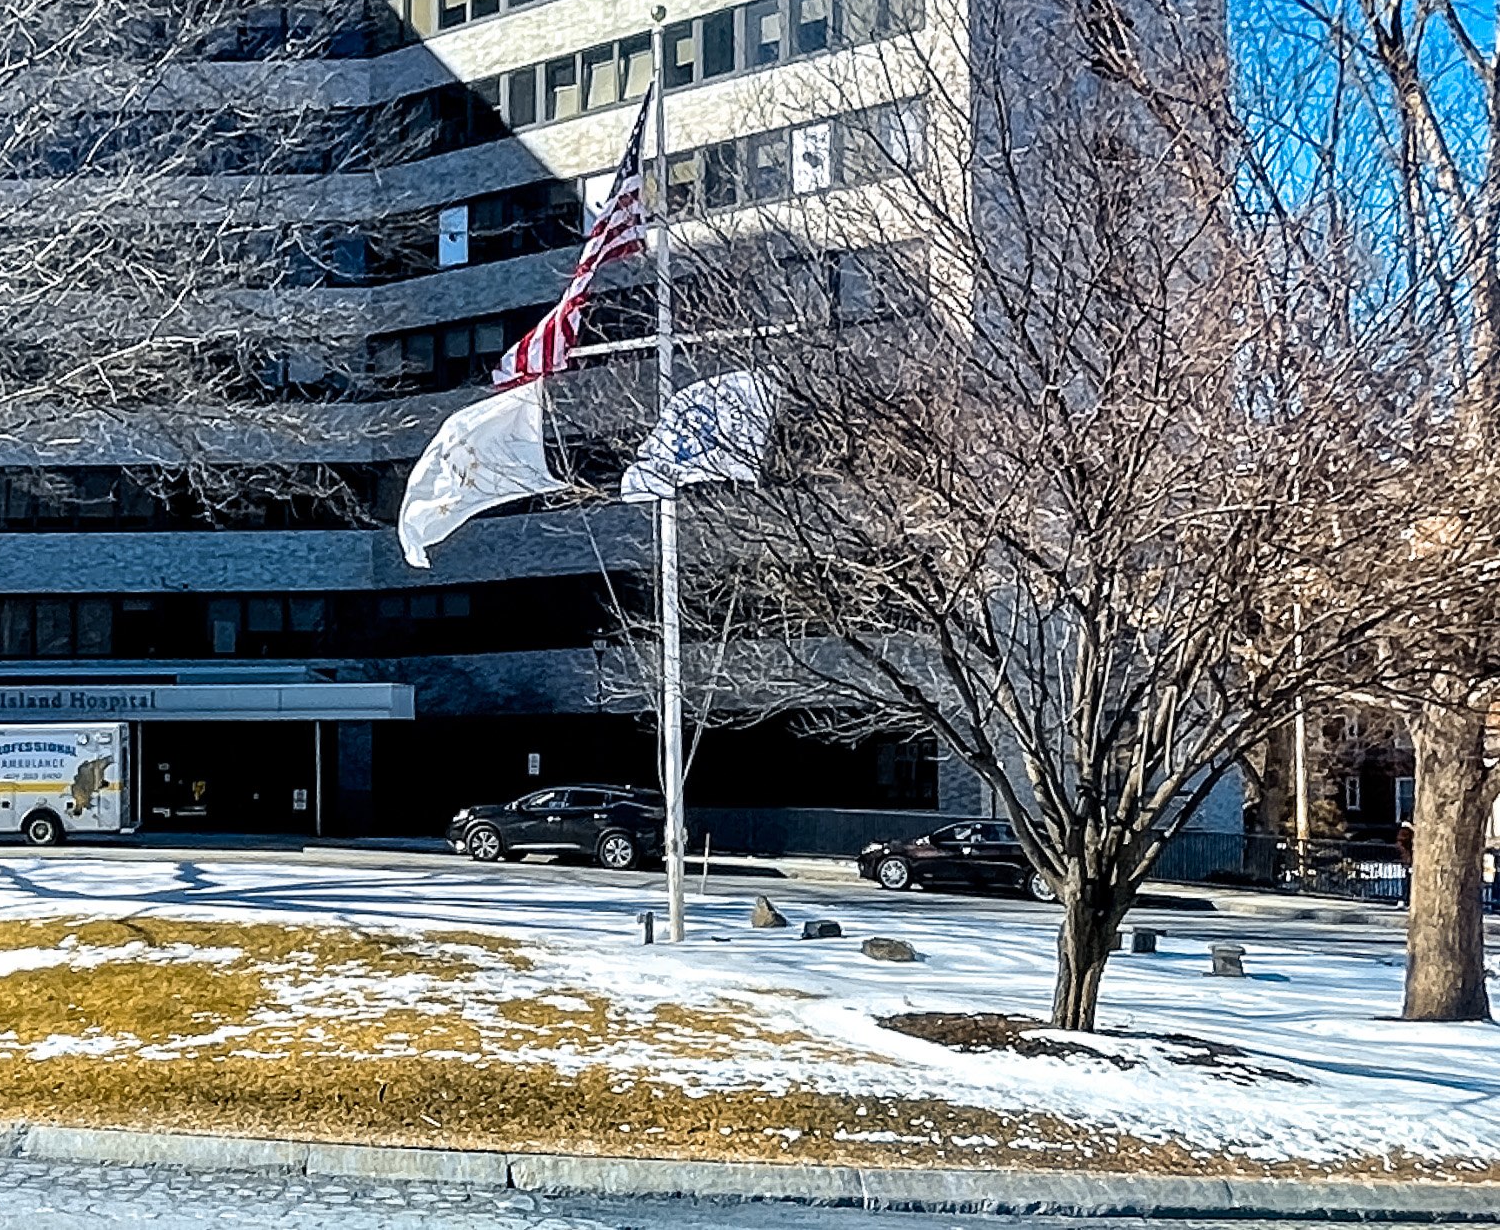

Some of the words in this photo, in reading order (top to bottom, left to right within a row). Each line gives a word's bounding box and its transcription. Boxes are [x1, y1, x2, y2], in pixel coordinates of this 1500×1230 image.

[0, 691, 62, 709] Island
[69, 691, 156, 712] Hospital
[1, 758, 65, 769] AMBULANCE
